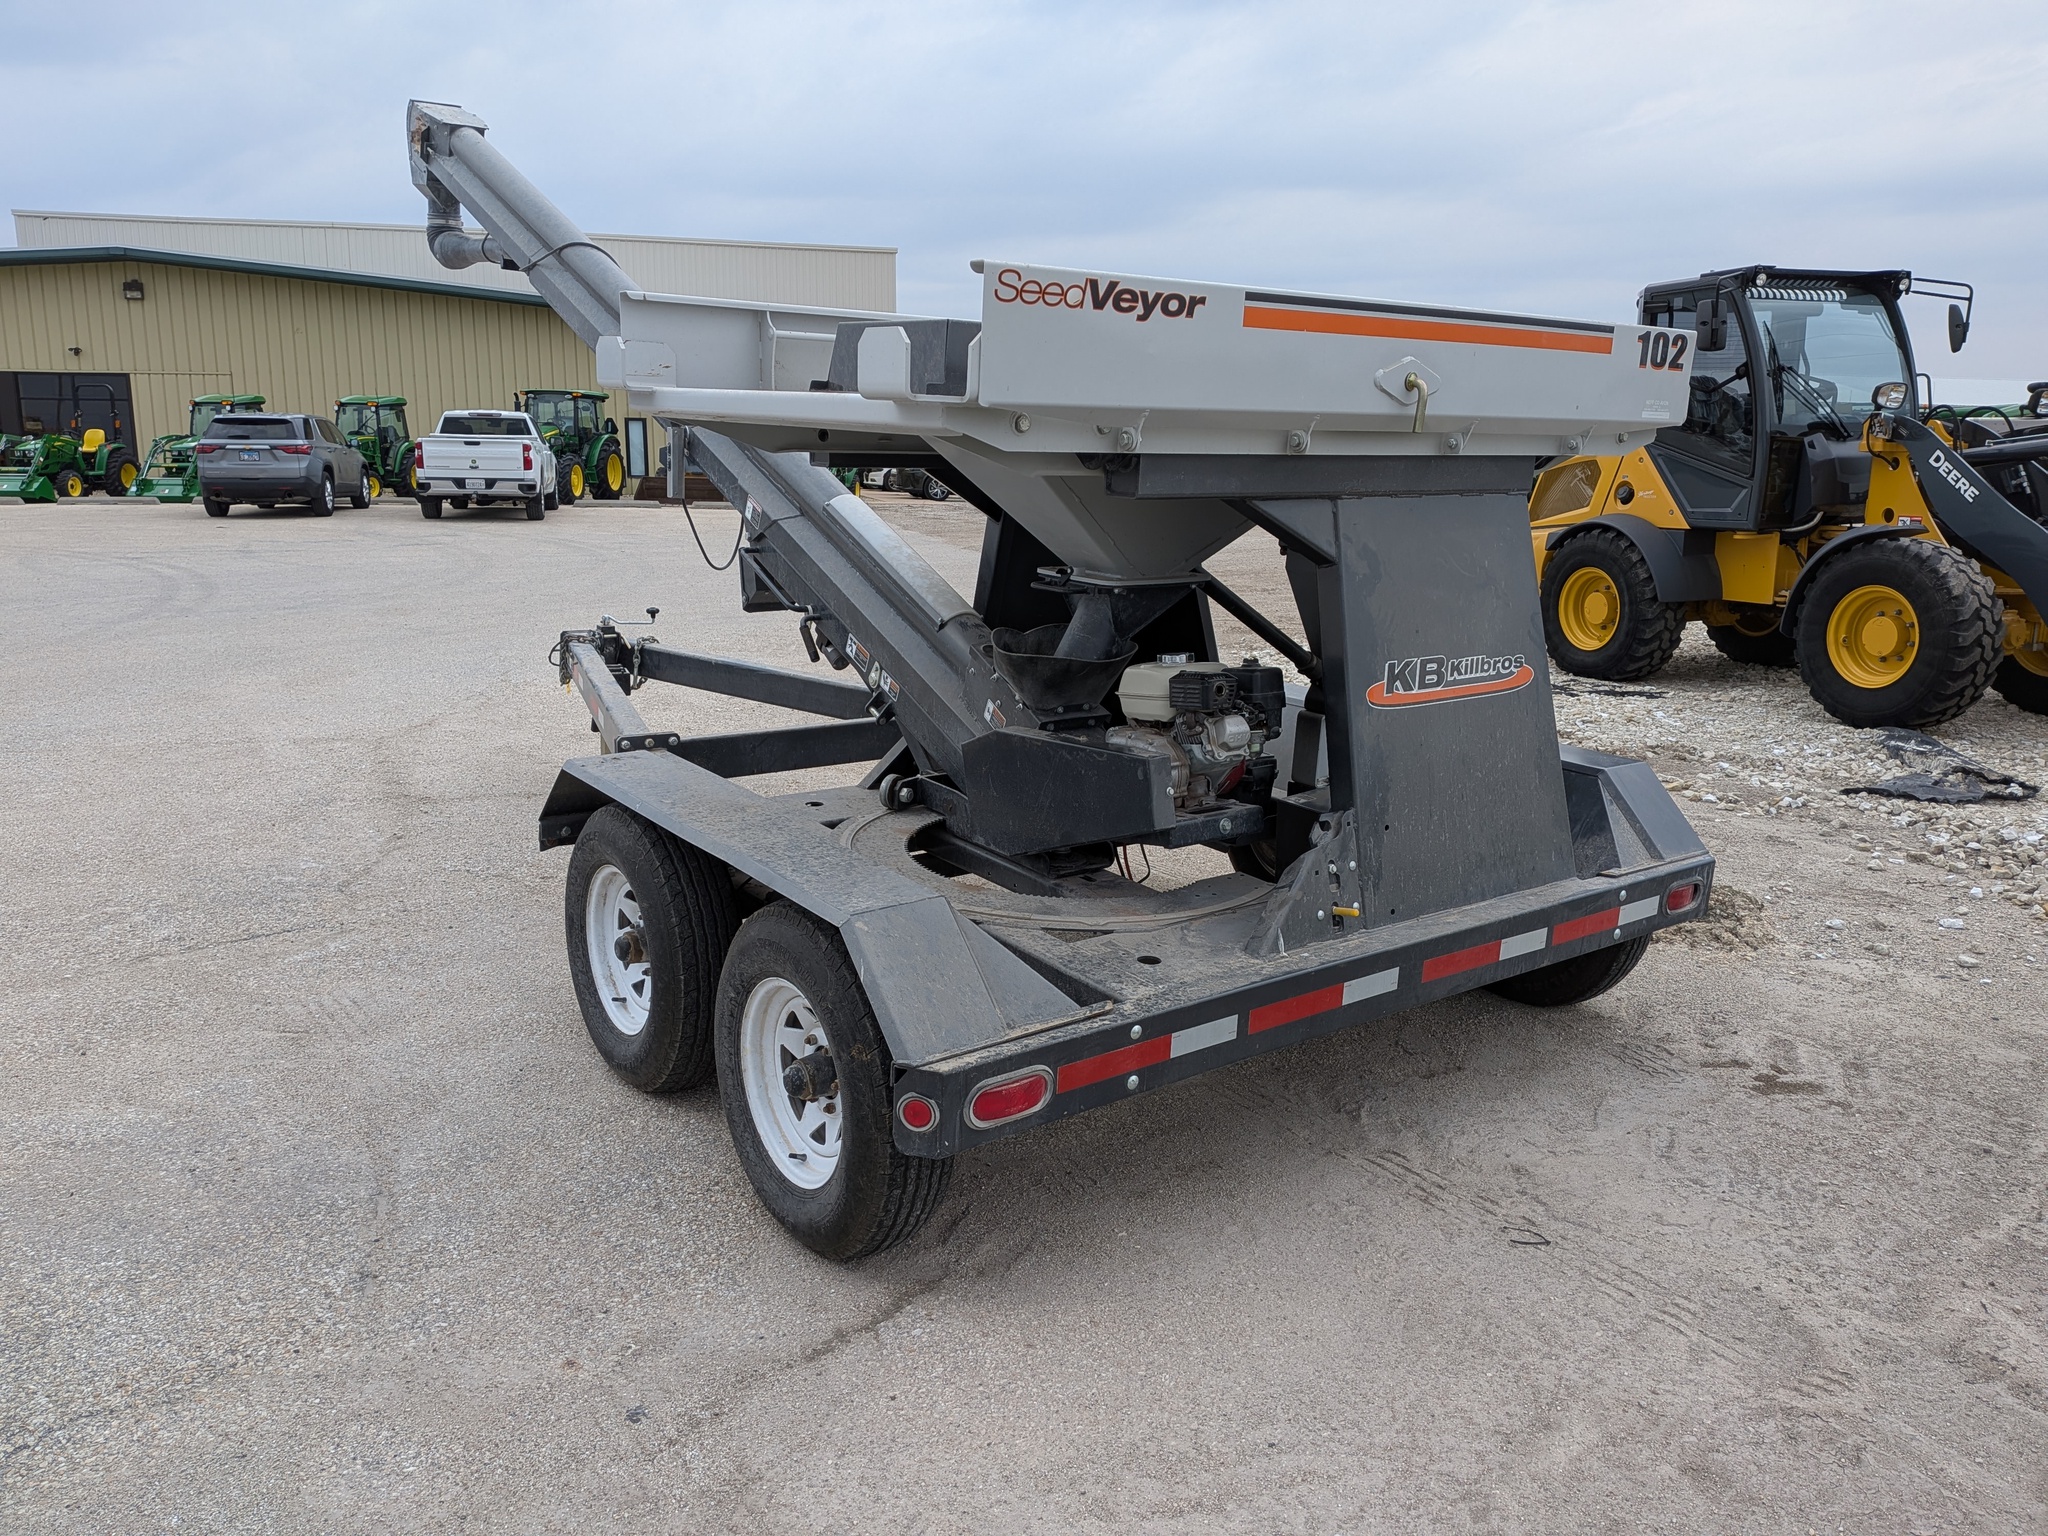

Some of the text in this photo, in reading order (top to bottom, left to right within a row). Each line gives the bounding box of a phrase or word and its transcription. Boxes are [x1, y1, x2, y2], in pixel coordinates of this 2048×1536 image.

[994, 268, 1207, 323] SeedVeyor
[1637, 330, 1688, 372] 102
[1928, 449, 1980, 503] DEERE
[1384, 654, 1525, 697] KB Killbros
